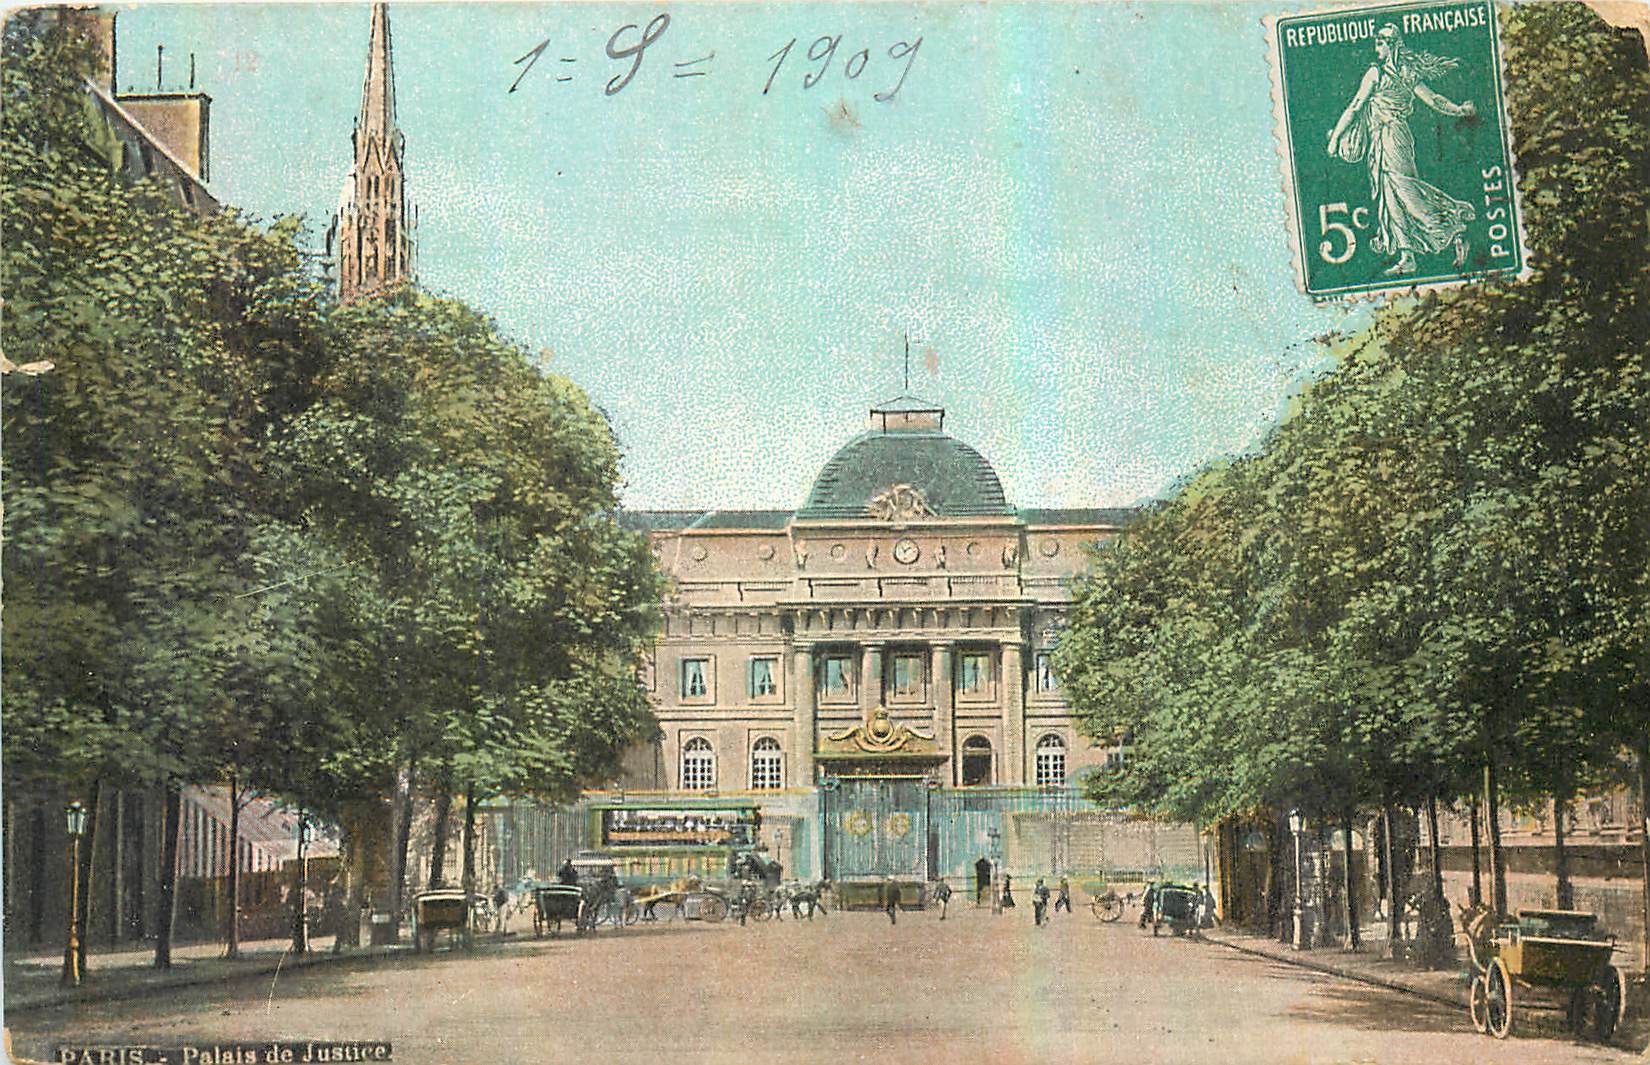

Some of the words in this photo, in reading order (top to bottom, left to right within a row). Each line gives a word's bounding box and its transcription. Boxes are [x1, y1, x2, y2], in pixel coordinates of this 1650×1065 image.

[1402, 6, 1486, 33] FRANÇAISE
[762, 34, 924, 101] 1909
[1482, 165, 1510, 258] POSTES
